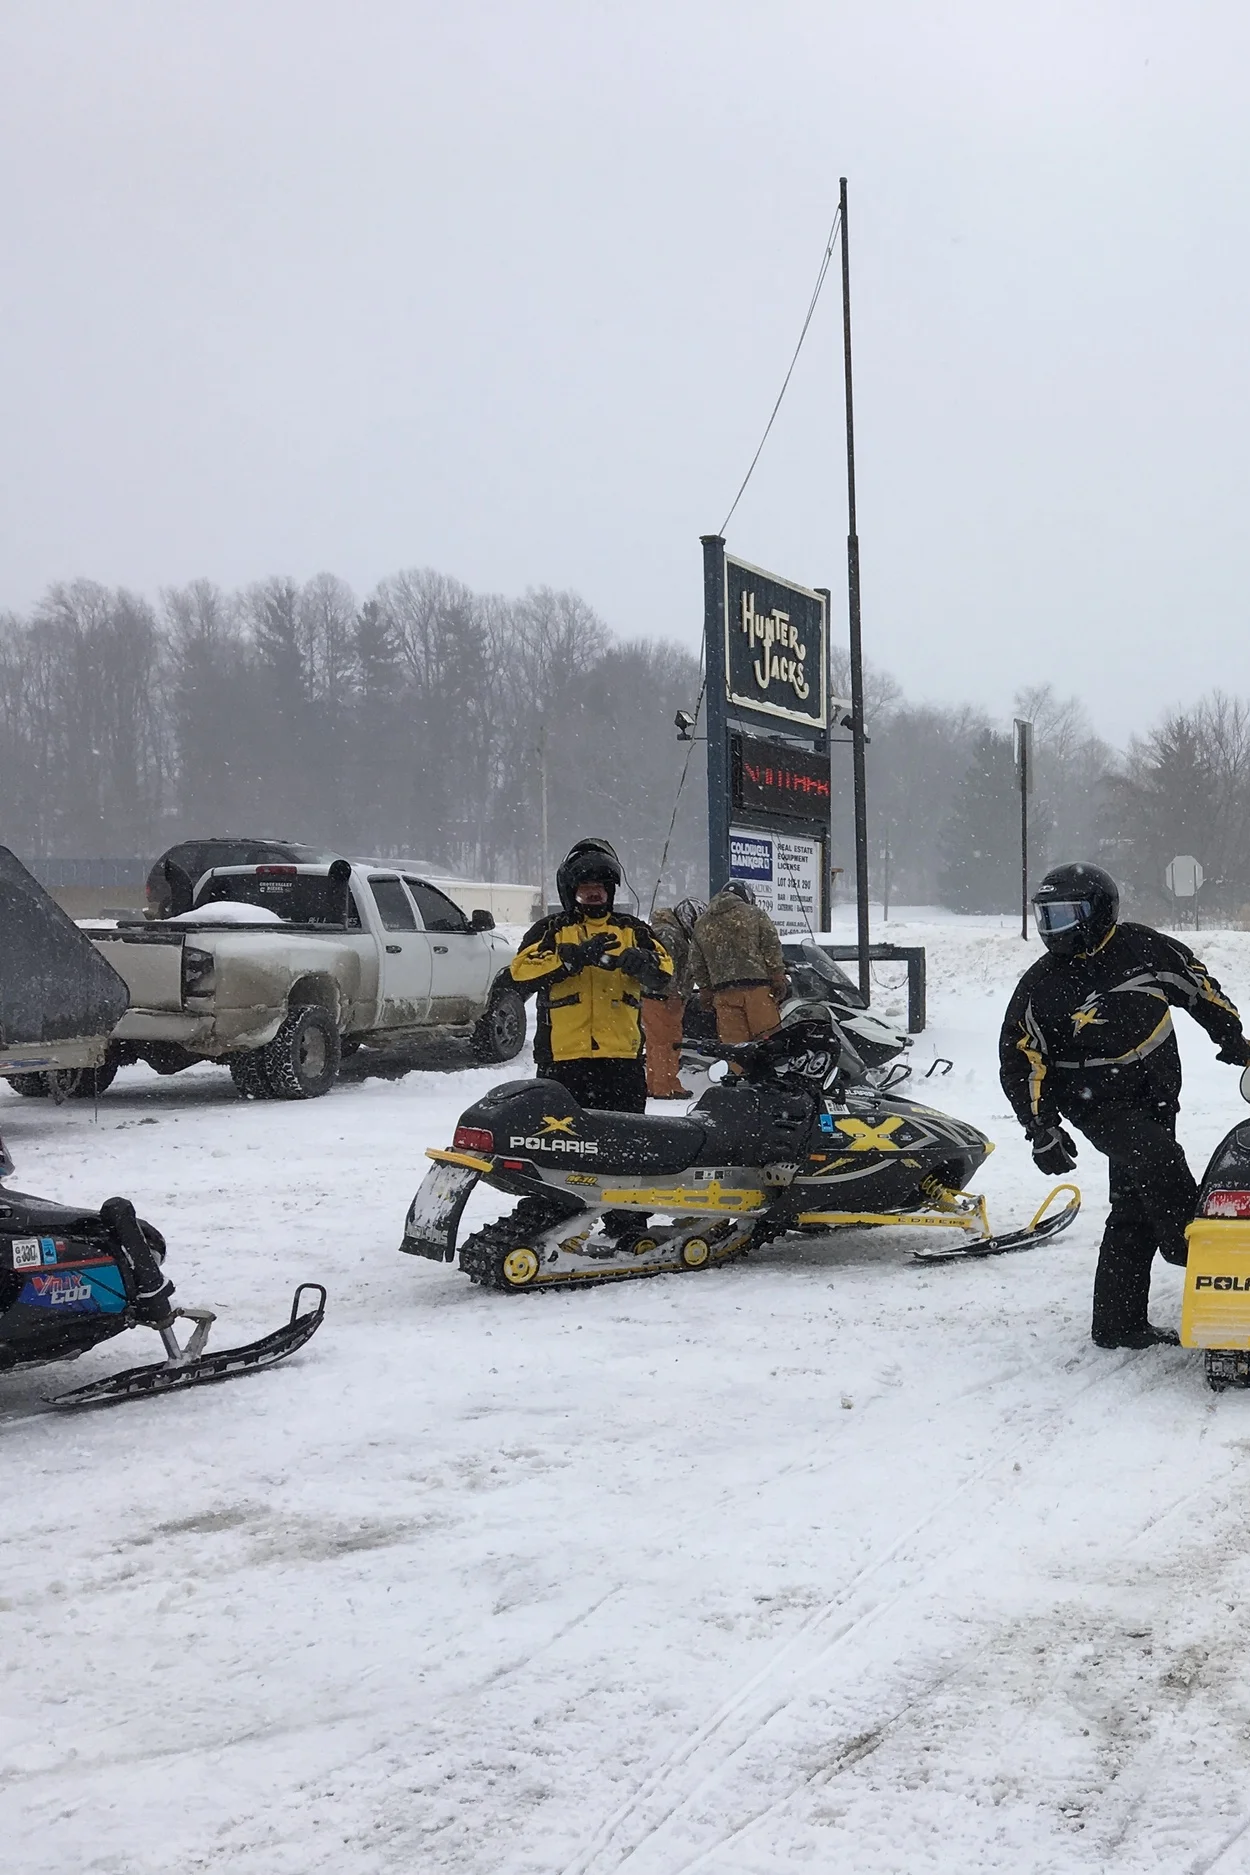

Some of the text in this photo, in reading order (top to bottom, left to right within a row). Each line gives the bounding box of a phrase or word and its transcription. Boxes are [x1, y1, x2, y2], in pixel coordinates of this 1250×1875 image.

[741, 590, 806, 661] HUNTER
[754, 639, 809, 700] JACKS
[778, 843, 813, 854] REAL ESTATE
[778, 852, 808, 863] EQUIPMENT
[778, 862, 800, 871] LICENSE
[778, 877, 786, 887] LOT
[509, 1136, 599, 1154] POLARIS
